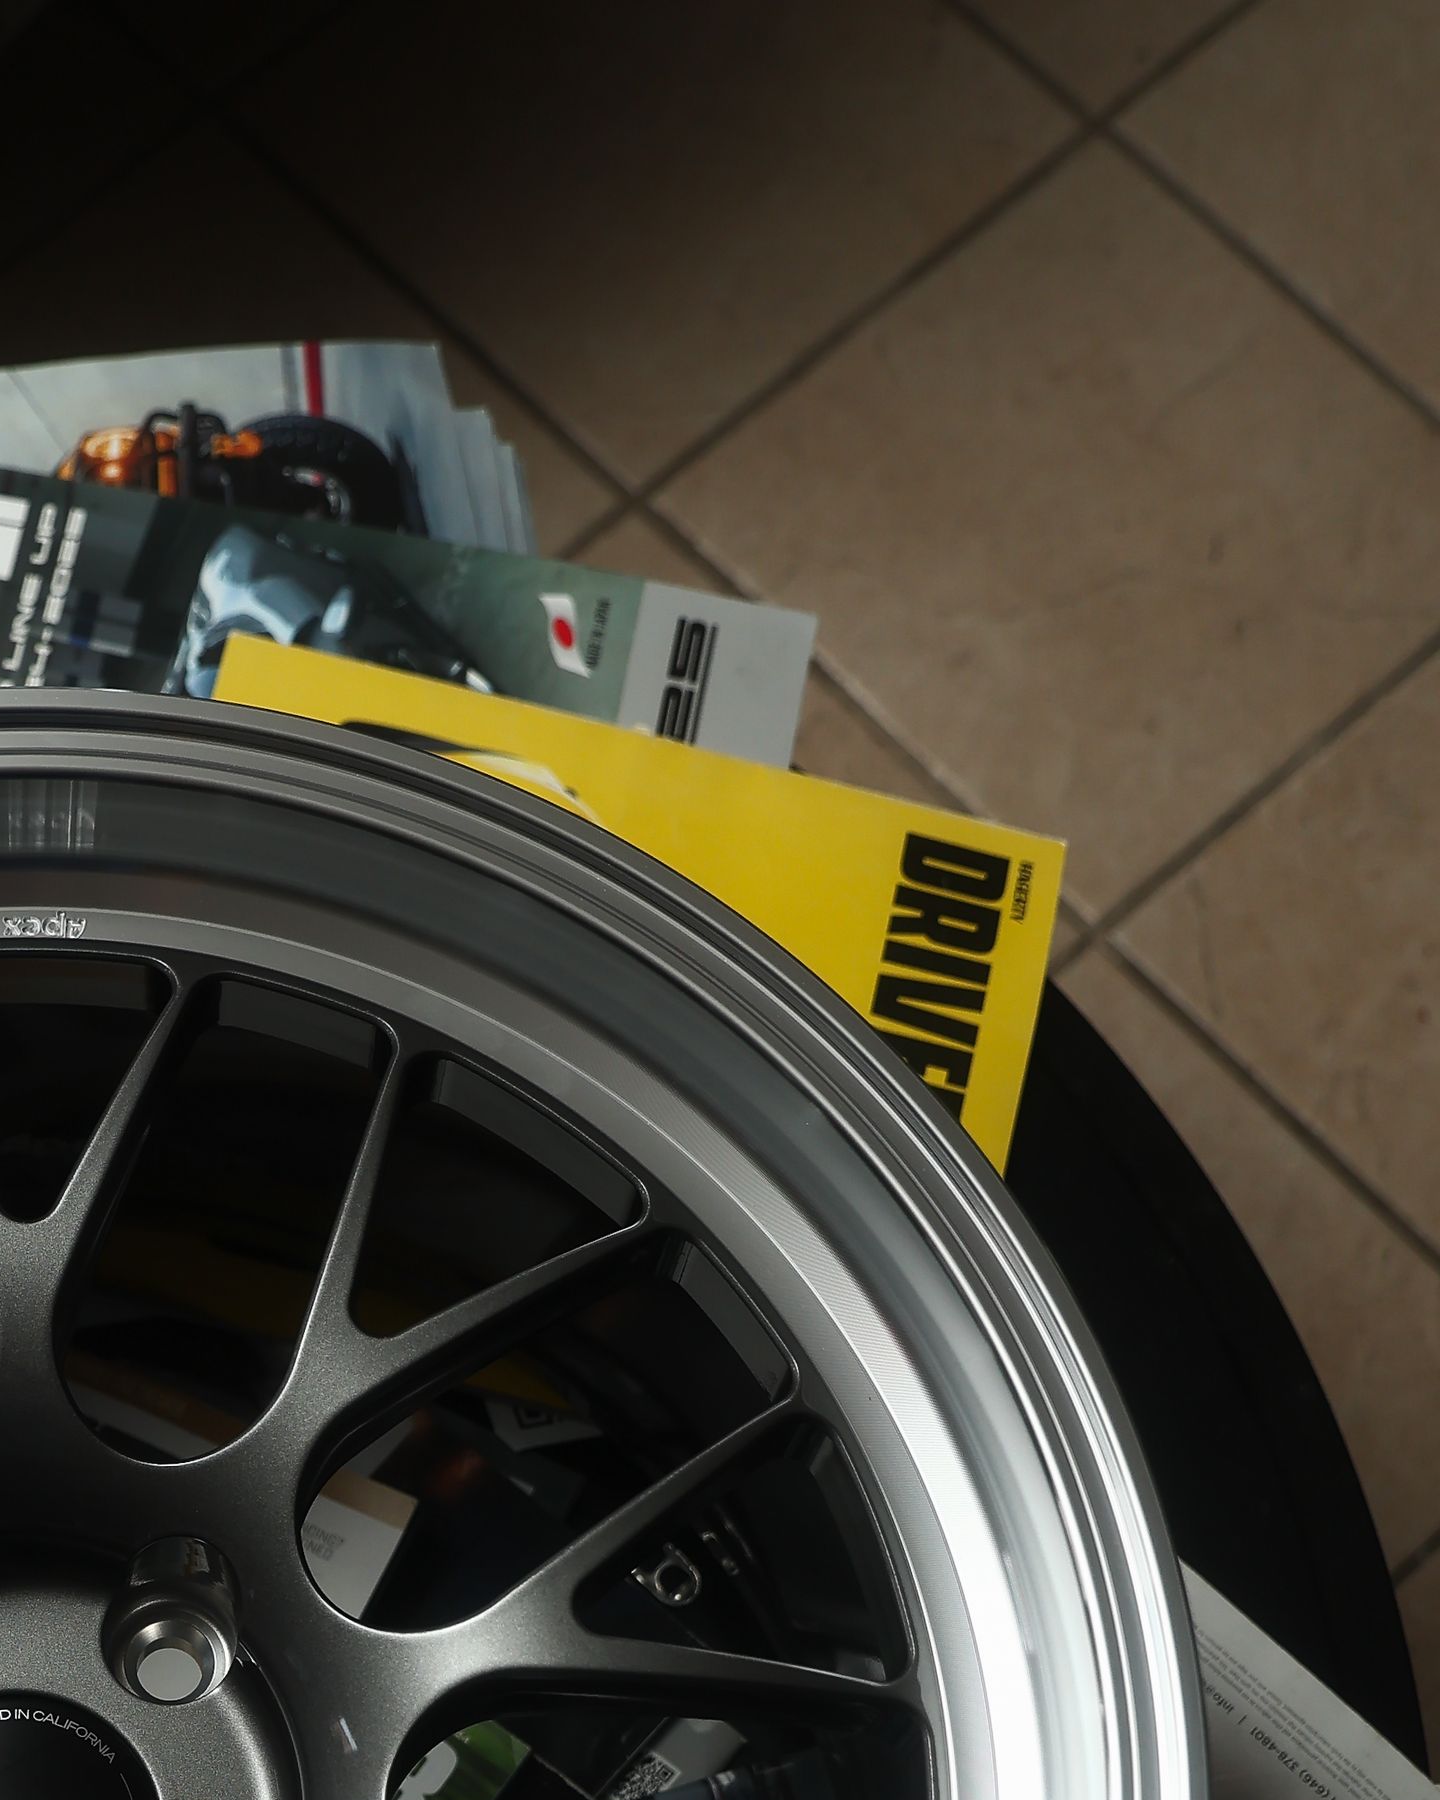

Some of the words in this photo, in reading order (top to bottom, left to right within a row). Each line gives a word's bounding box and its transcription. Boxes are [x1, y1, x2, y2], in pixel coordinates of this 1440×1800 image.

[2, 572, 42, 671] LINE
[29, 502, 58, 565] UP
[2, 911, 87, 939] Apex
[14, 1708, 31, 1720] IN
[32, 1709, 116, 1765] CALIFORNIA
